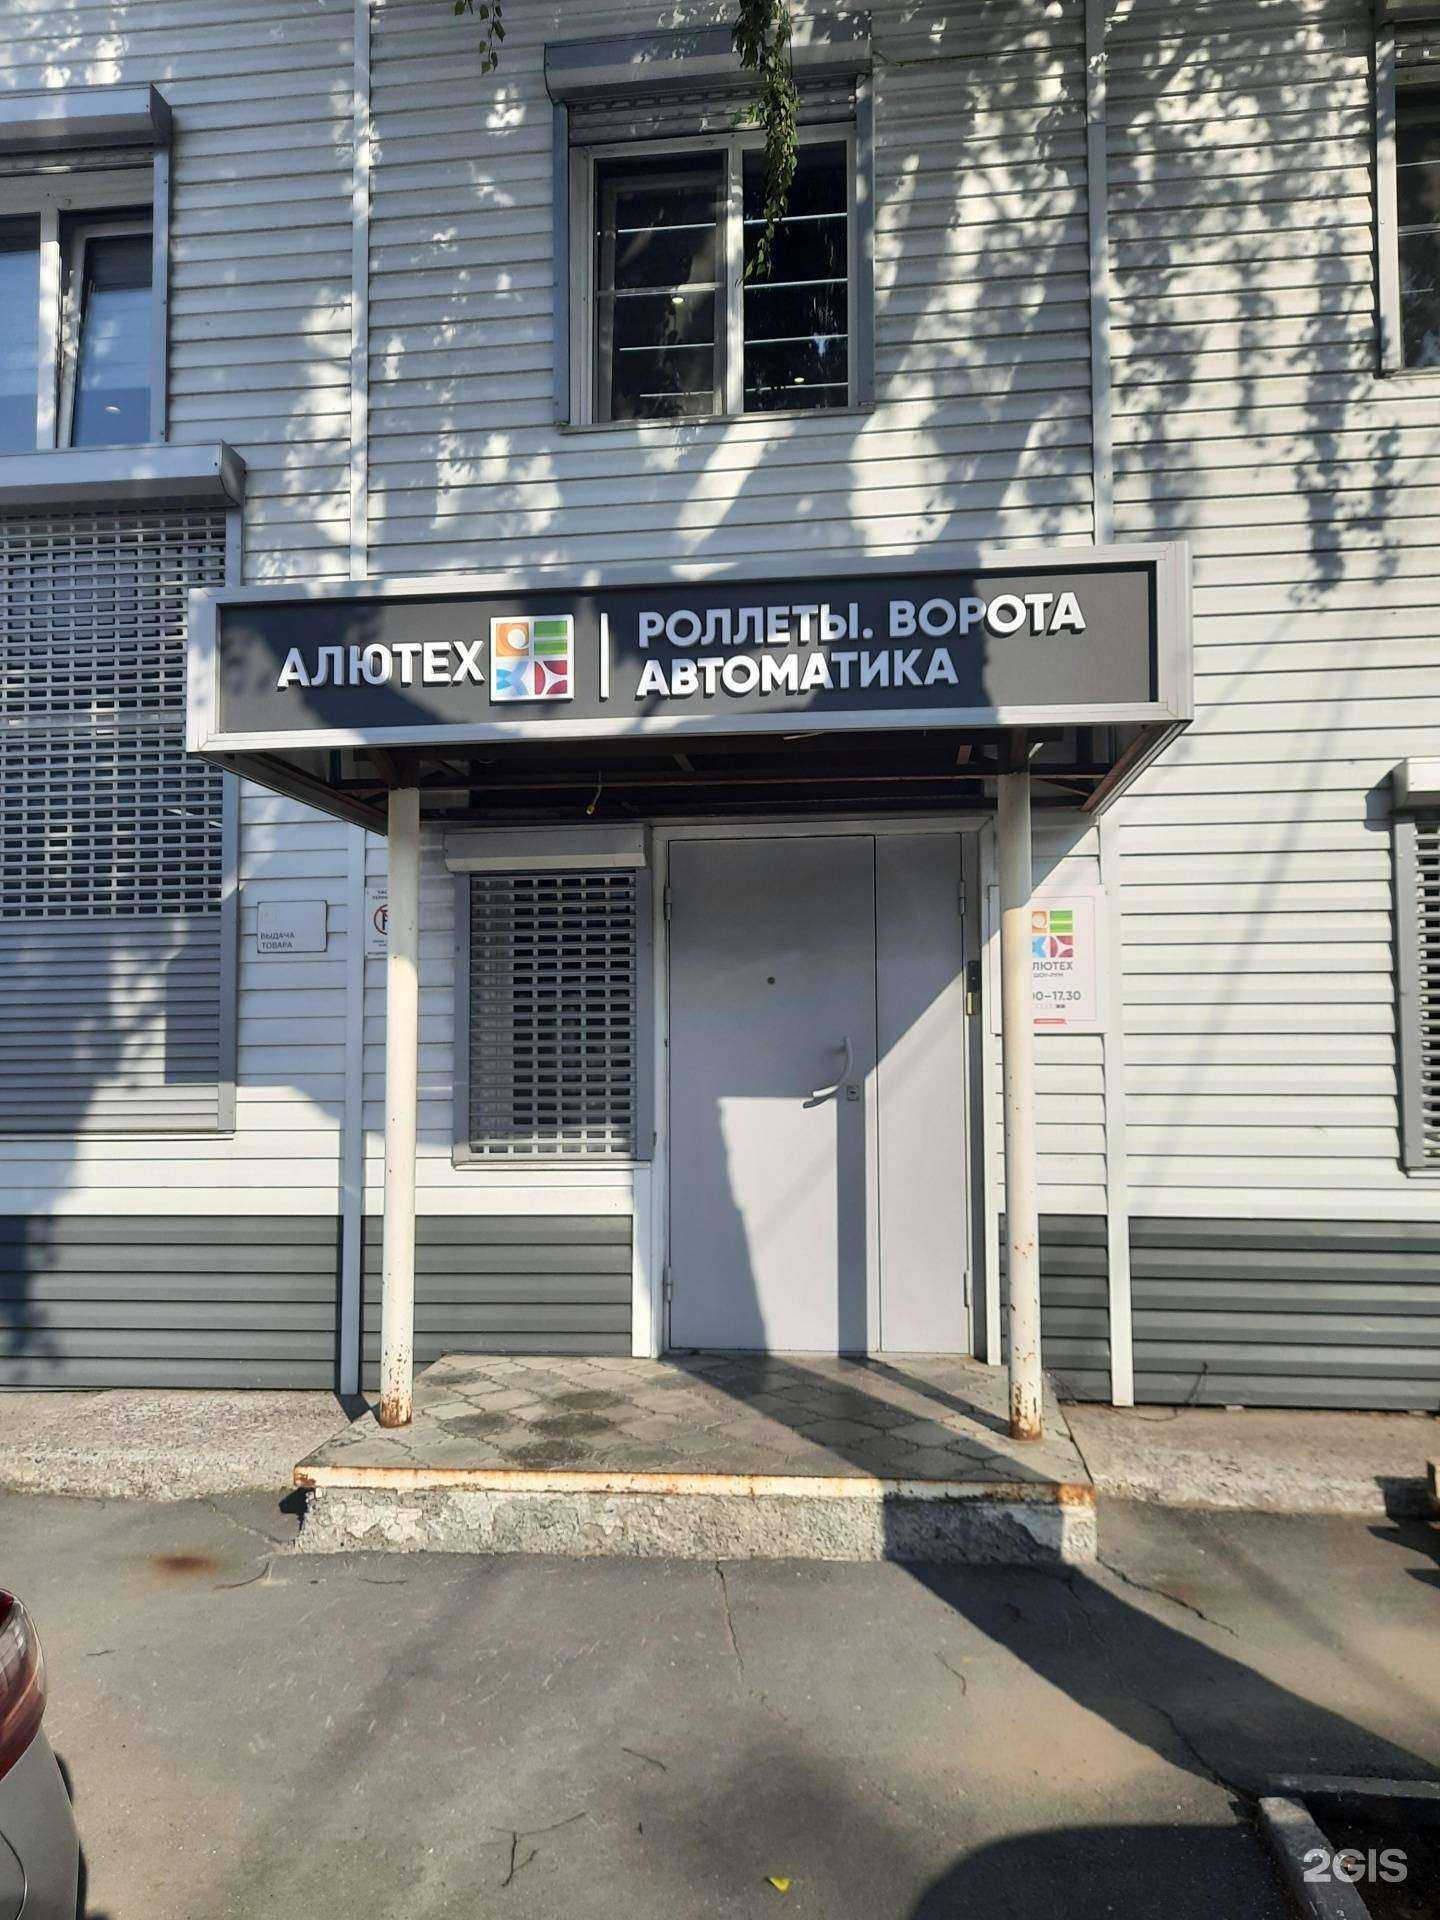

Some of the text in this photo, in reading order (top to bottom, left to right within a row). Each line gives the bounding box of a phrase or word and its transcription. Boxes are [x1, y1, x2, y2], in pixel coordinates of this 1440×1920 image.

[637, 592, 1087, 649] РОЛЛЕТЫ. ВОРОТА
[277, 640, 485, 691] АЛЮТЕХ
[634, 647, 959, 699] АВТОМАТИКА
[260, 932, 295, 940] ВЫДАЧА
[262, 941, 293, 949] ТОВАРА
[1032, 961, 1073, 971] ЛЮТЕХ
